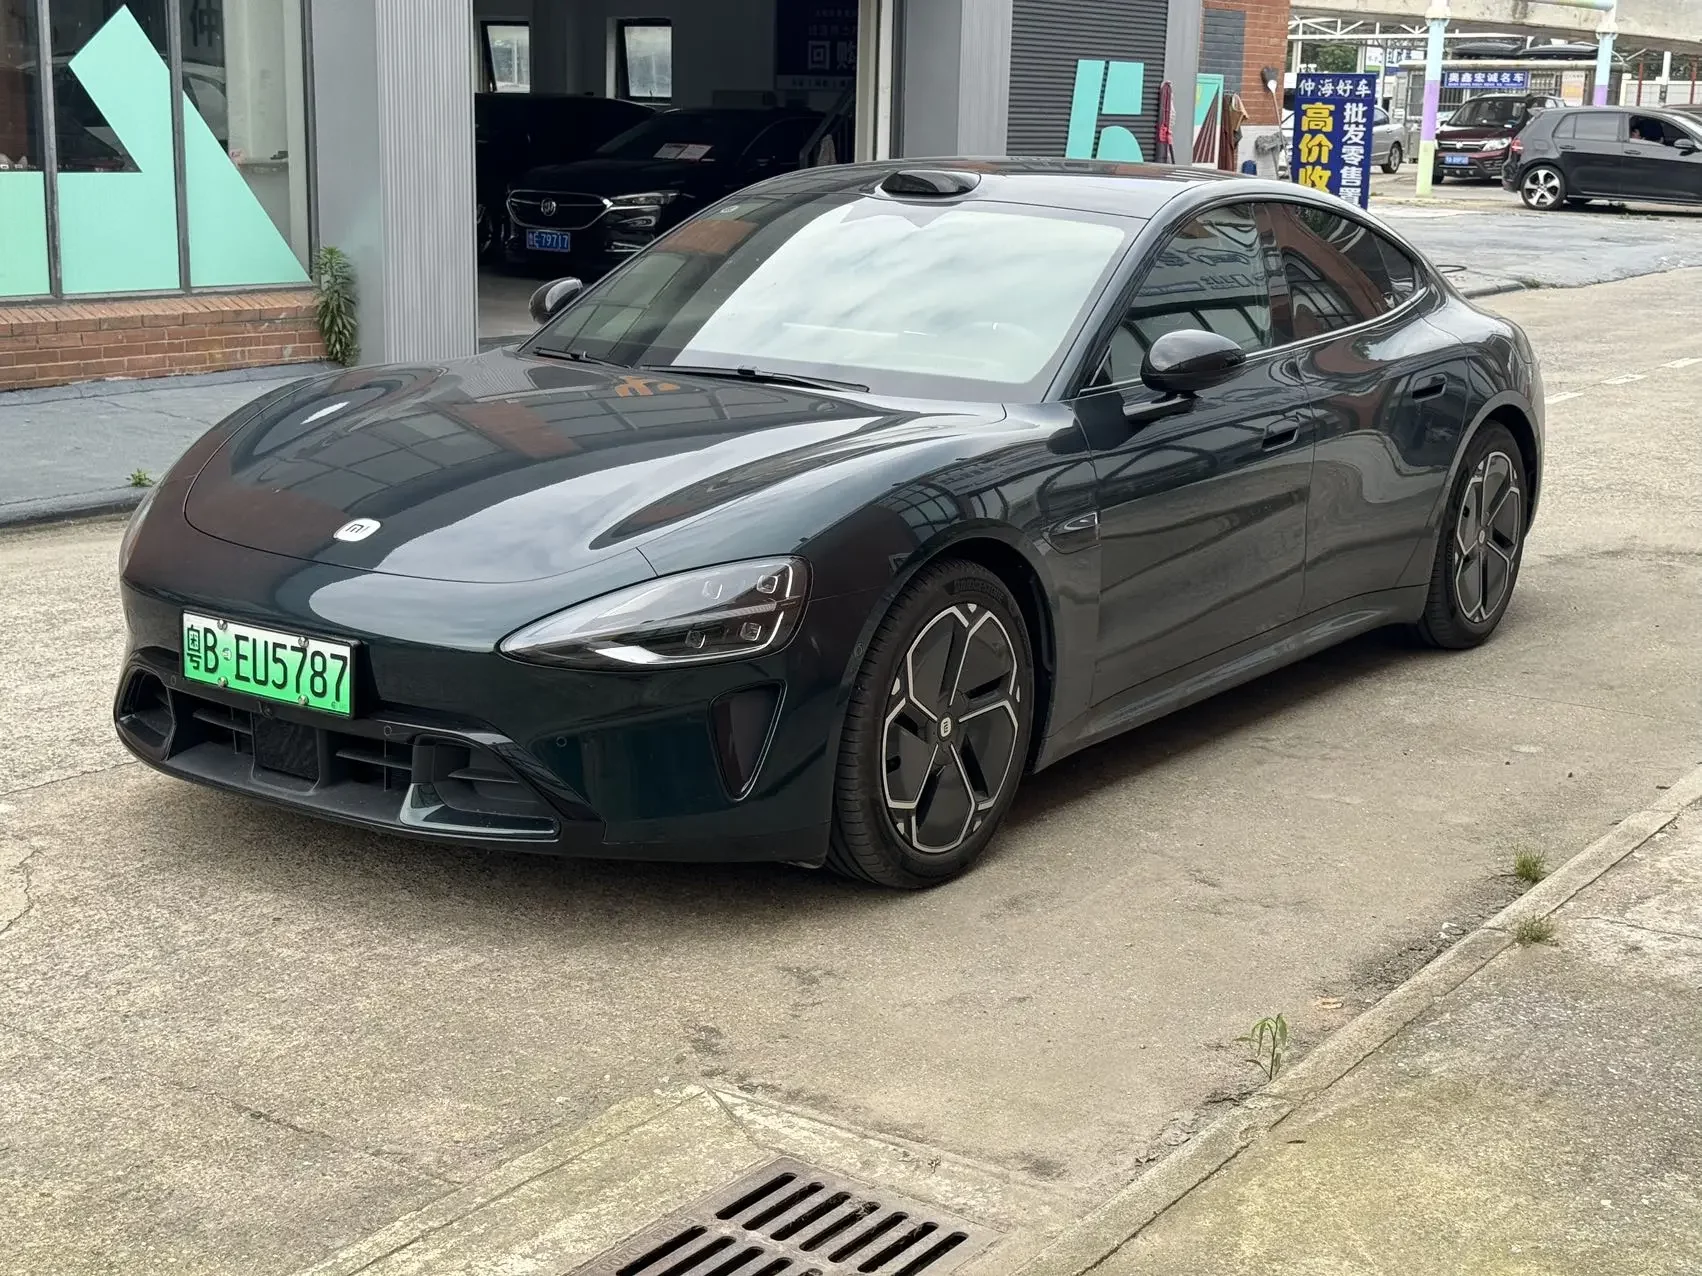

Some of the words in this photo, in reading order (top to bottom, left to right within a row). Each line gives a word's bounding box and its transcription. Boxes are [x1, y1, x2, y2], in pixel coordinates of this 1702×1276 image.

[1298, 78, 1372, 98] 仲海好车
[1298, 102, 1336, 193] 高价收
